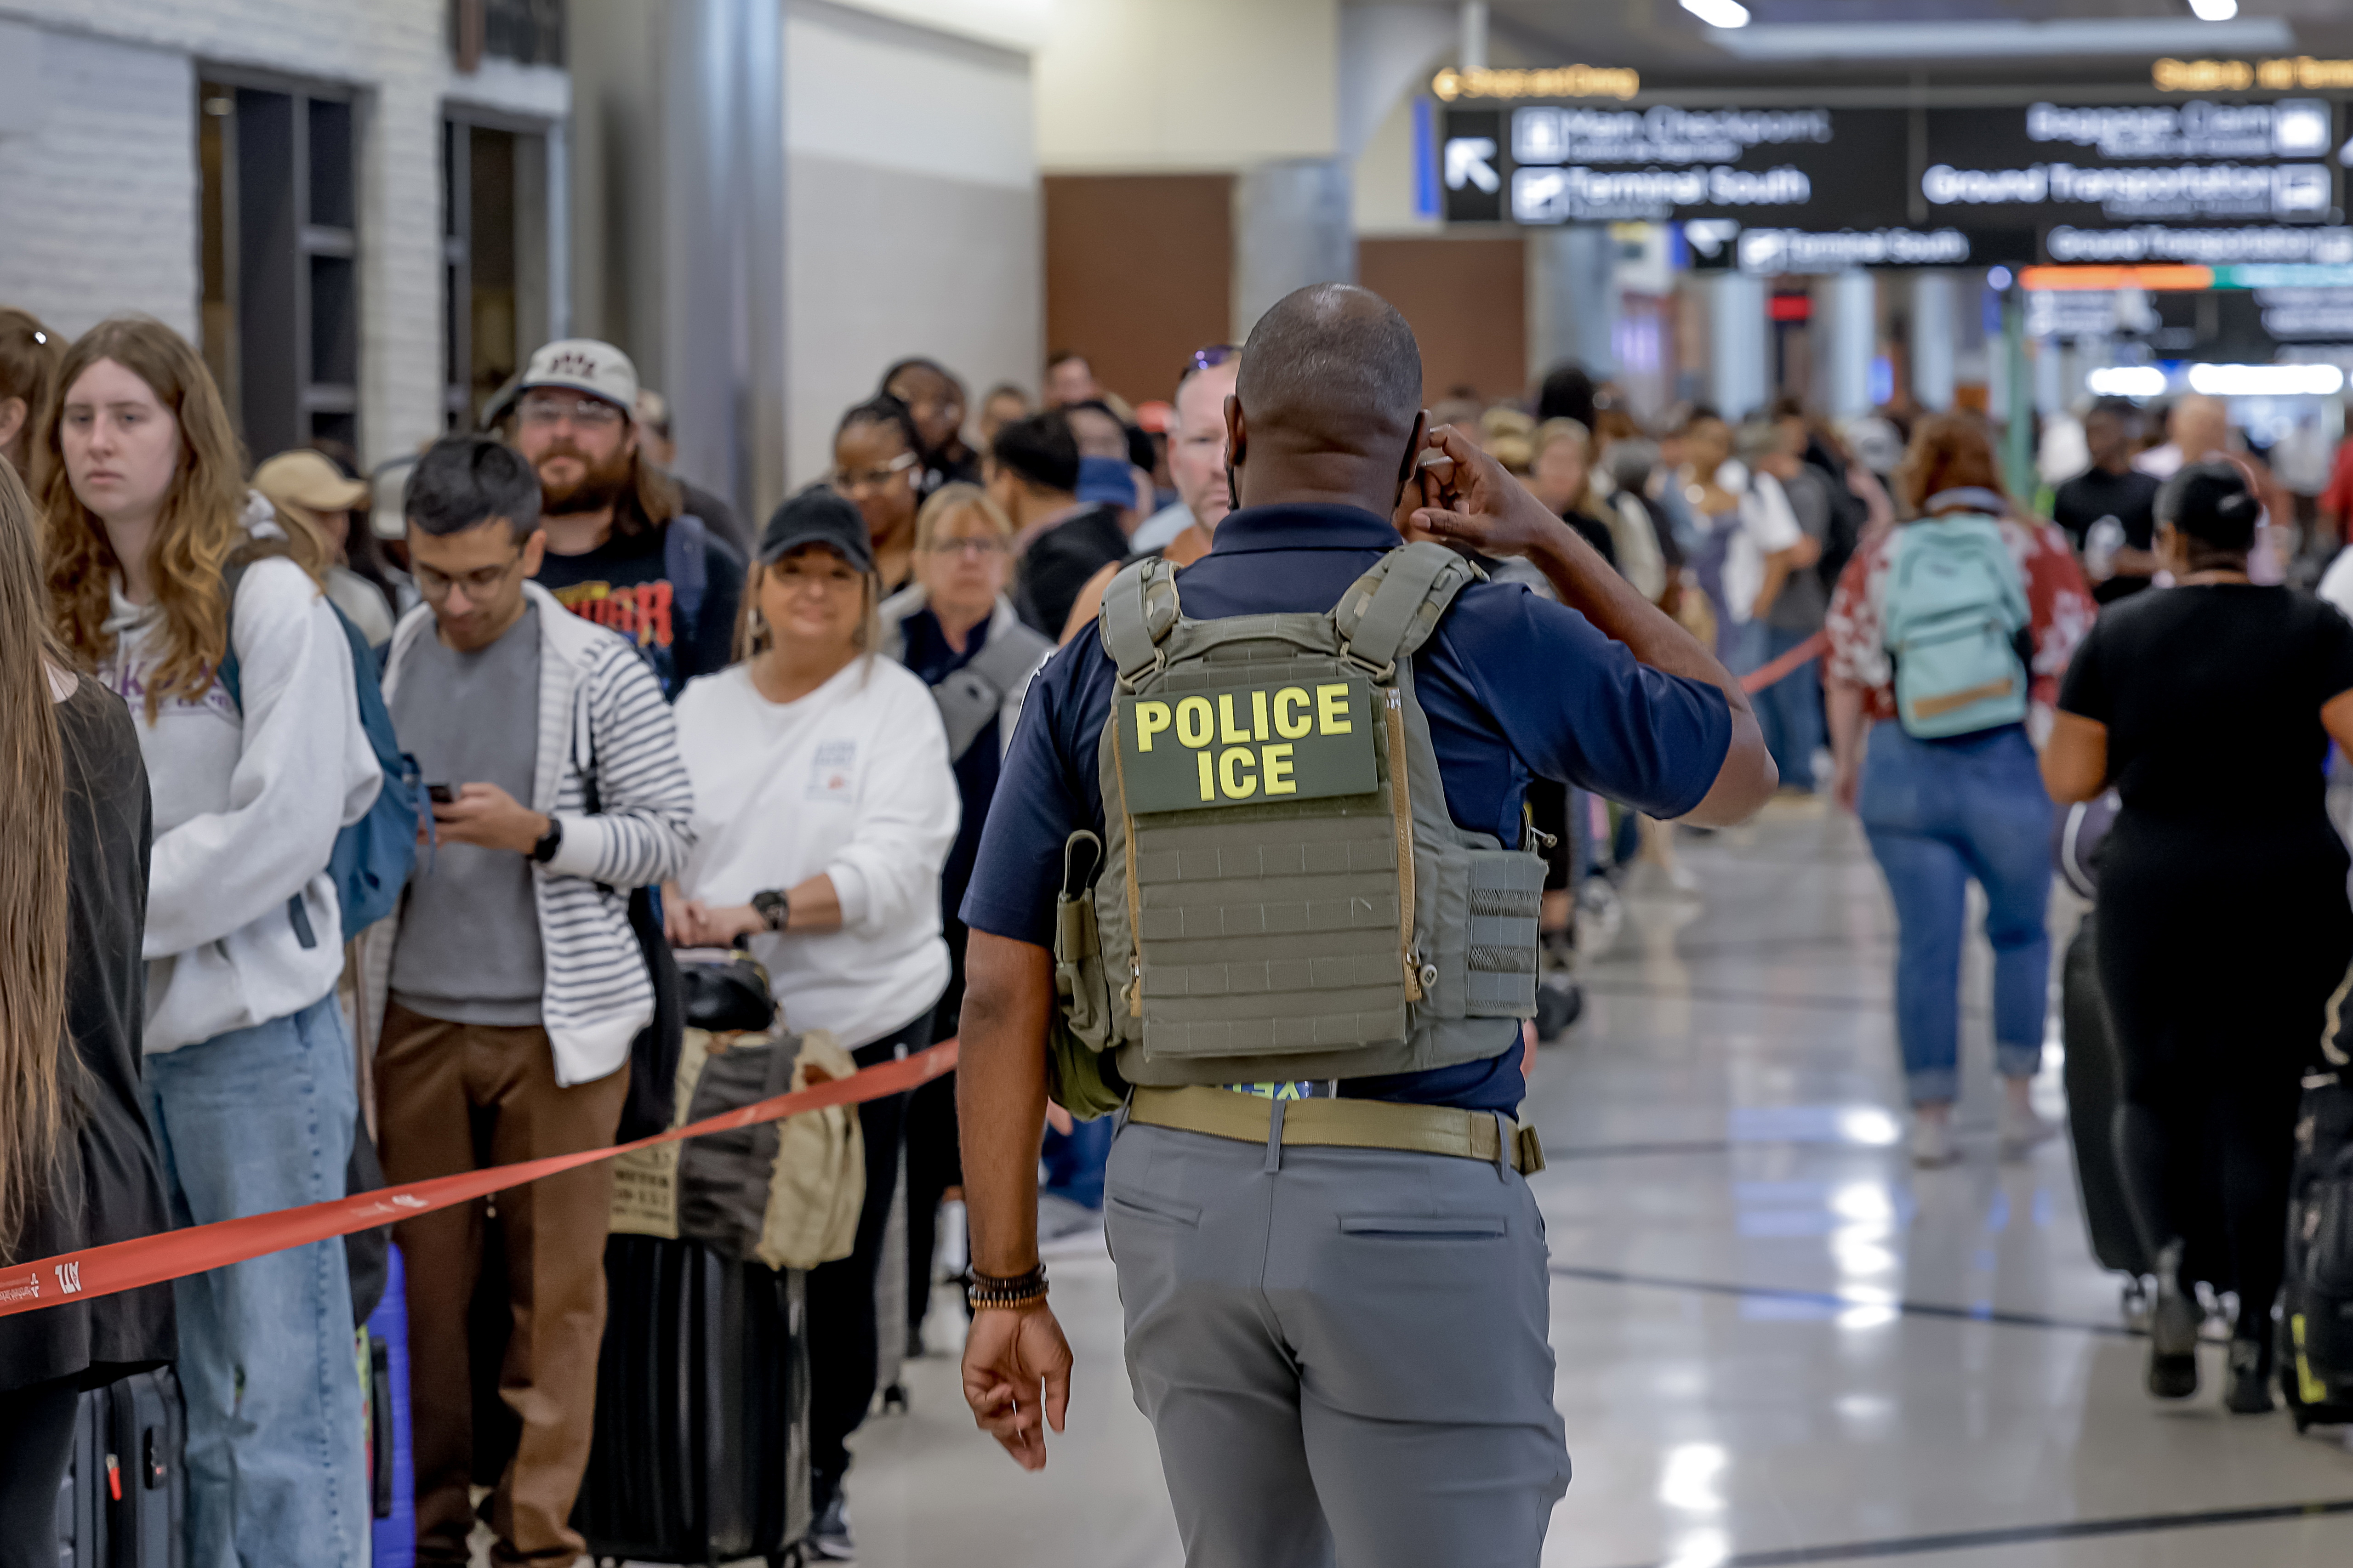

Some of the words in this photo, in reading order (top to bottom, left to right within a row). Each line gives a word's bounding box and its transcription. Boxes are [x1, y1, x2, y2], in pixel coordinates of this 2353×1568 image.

[1571, 166, 1709, 204] Terminal
[1709, 165, 1811, 204] South
[1922, 163, 2048, 203] Ground
[1135, 683, 1352, 753] POLICE
[1197, 742, 1297, 802] ICE
[55, 1261, 81, 1294] ATL
